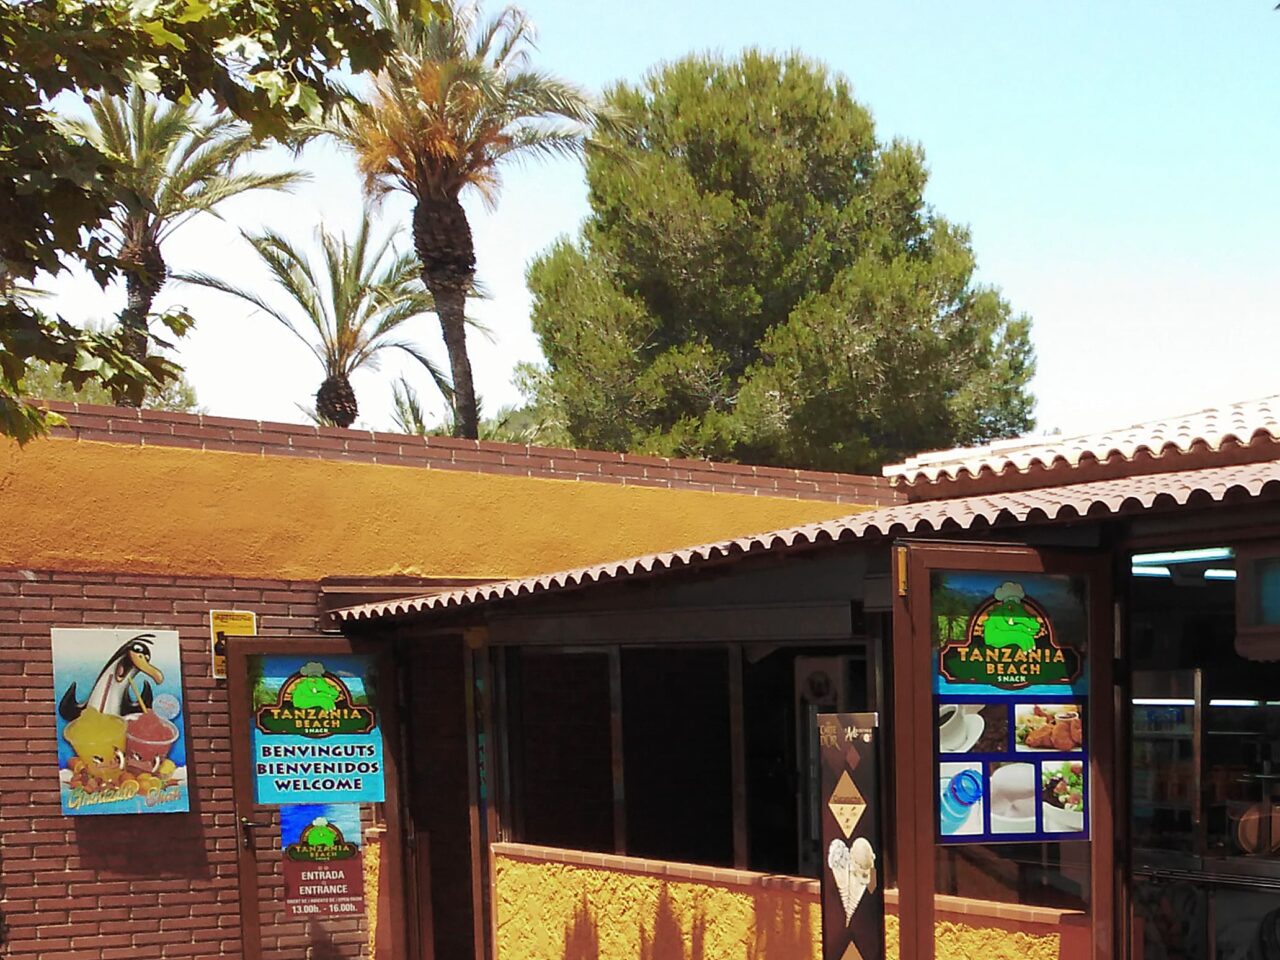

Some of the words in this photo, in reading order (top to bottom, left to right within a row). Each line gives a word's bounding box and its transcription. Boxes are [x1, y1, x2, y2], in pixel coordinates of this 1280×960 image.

[957, 648, 1065, 662] TANZANIA
[986, 663, 1040, 674] BEACH
[270, 708, 361, 719] TANZANIA
[295, 720, 340, 728] BEACH
[261, 745, 375, 757] BENVINGUTS
[257, 762, 379, 775] BIENVENIDOS
[274, 778, 362, 791] WELCOME
[296, 845, 350, 853] TANZANIA
[301, 870, 345, 880] ENTRADA
[299, 885, 348, 895] ENTRANCE
[292, 905, 321, 914] 13.00h.
[329, 903, 358, 912] 16.00h.
